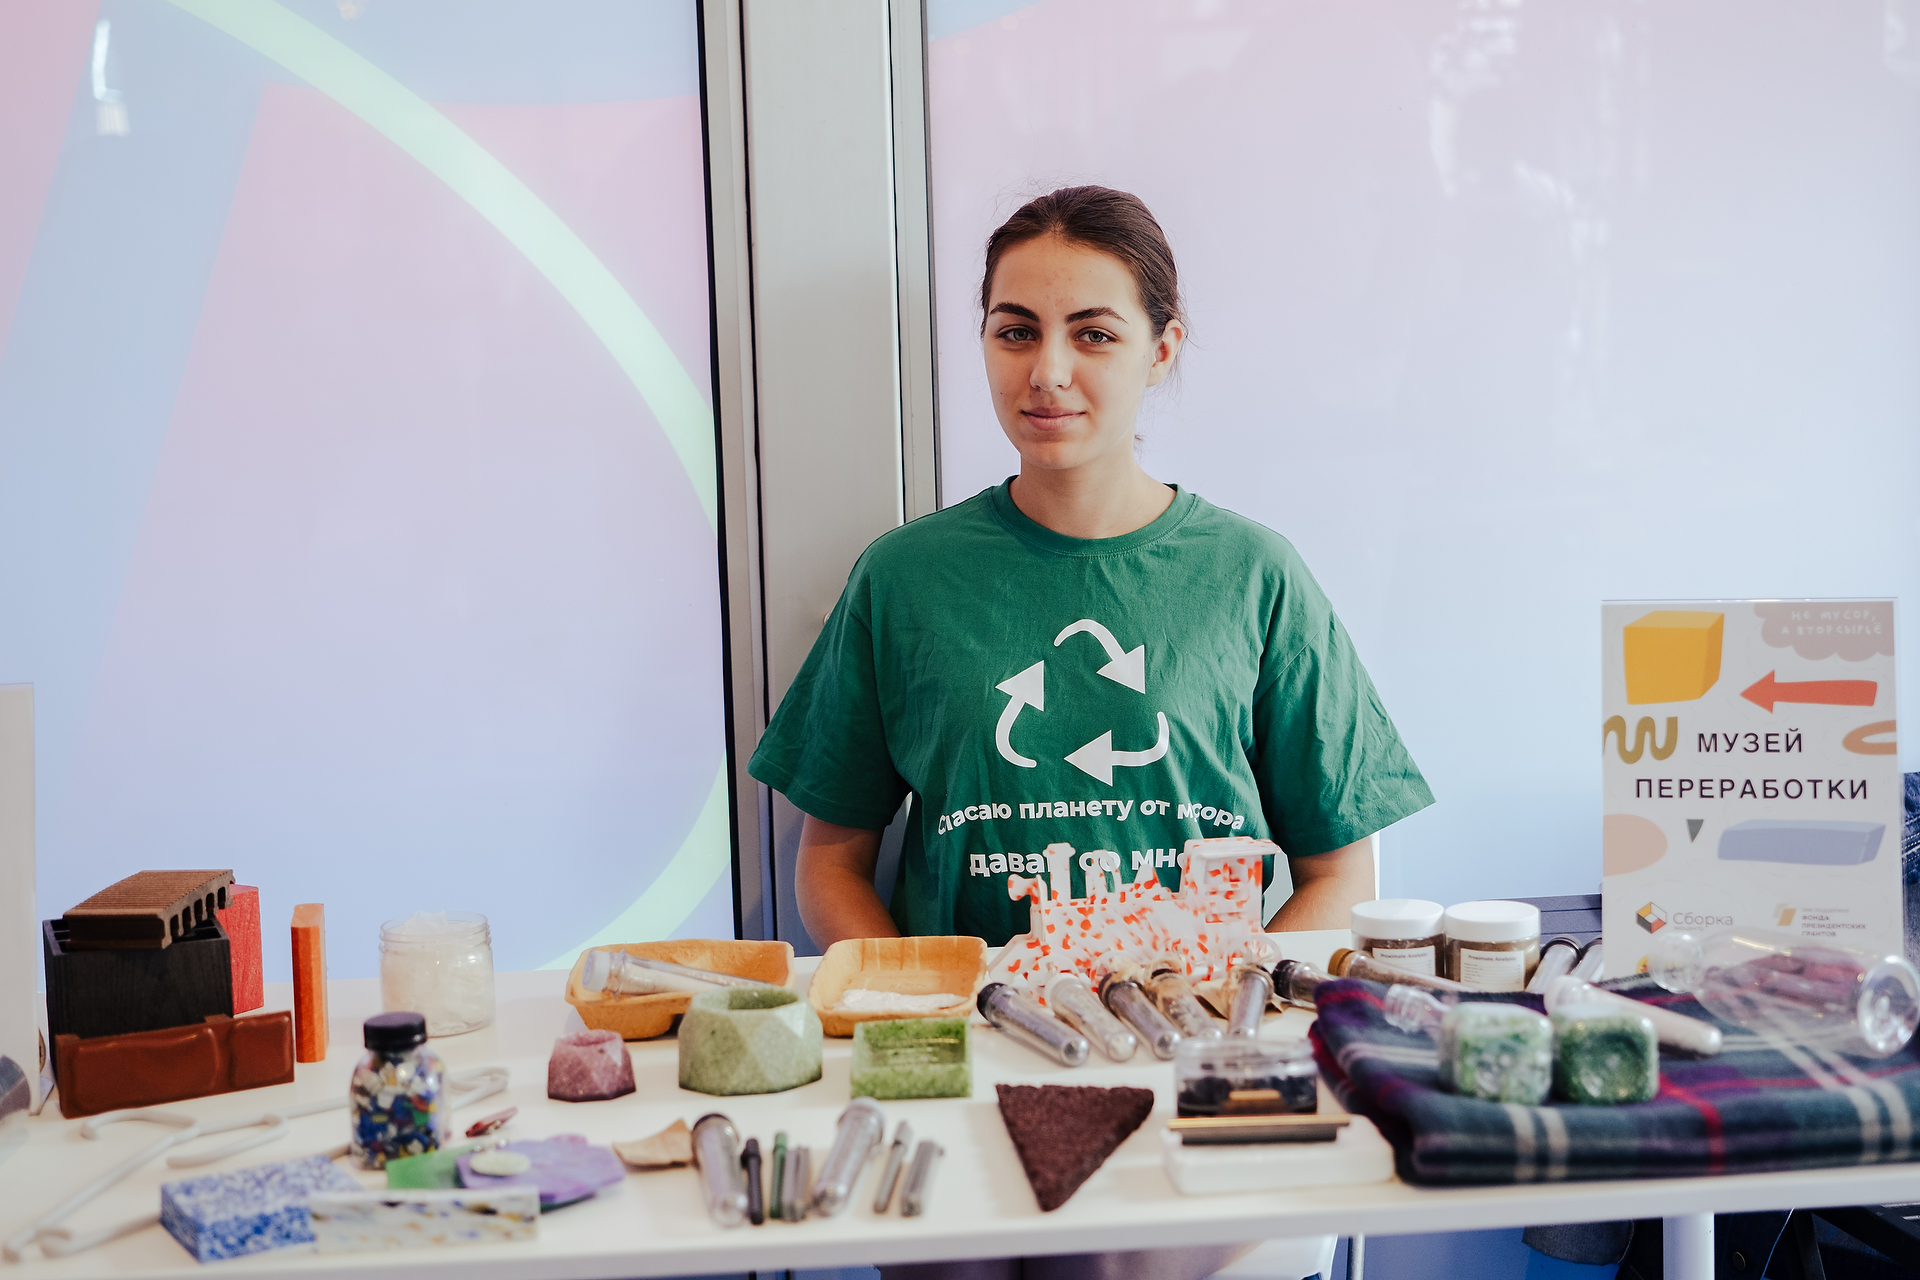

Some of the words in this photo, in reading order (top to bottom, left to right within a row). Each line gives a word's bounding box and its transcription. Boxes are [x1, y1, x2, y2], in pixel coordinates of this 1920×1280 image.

[1697, 727, 1803, 753] МУЗЕЙ
[1635, 778, 1868, 799] ПЕРЕРАБОТКИ
[1019, 800, 1134, 821] планету
[1140, 799, 1170, 816] от
[1177, 803, 1245, 830] мсора
[969, 852, 1051, 877] дава
[1672, 911, 1734, 927] Сборка
